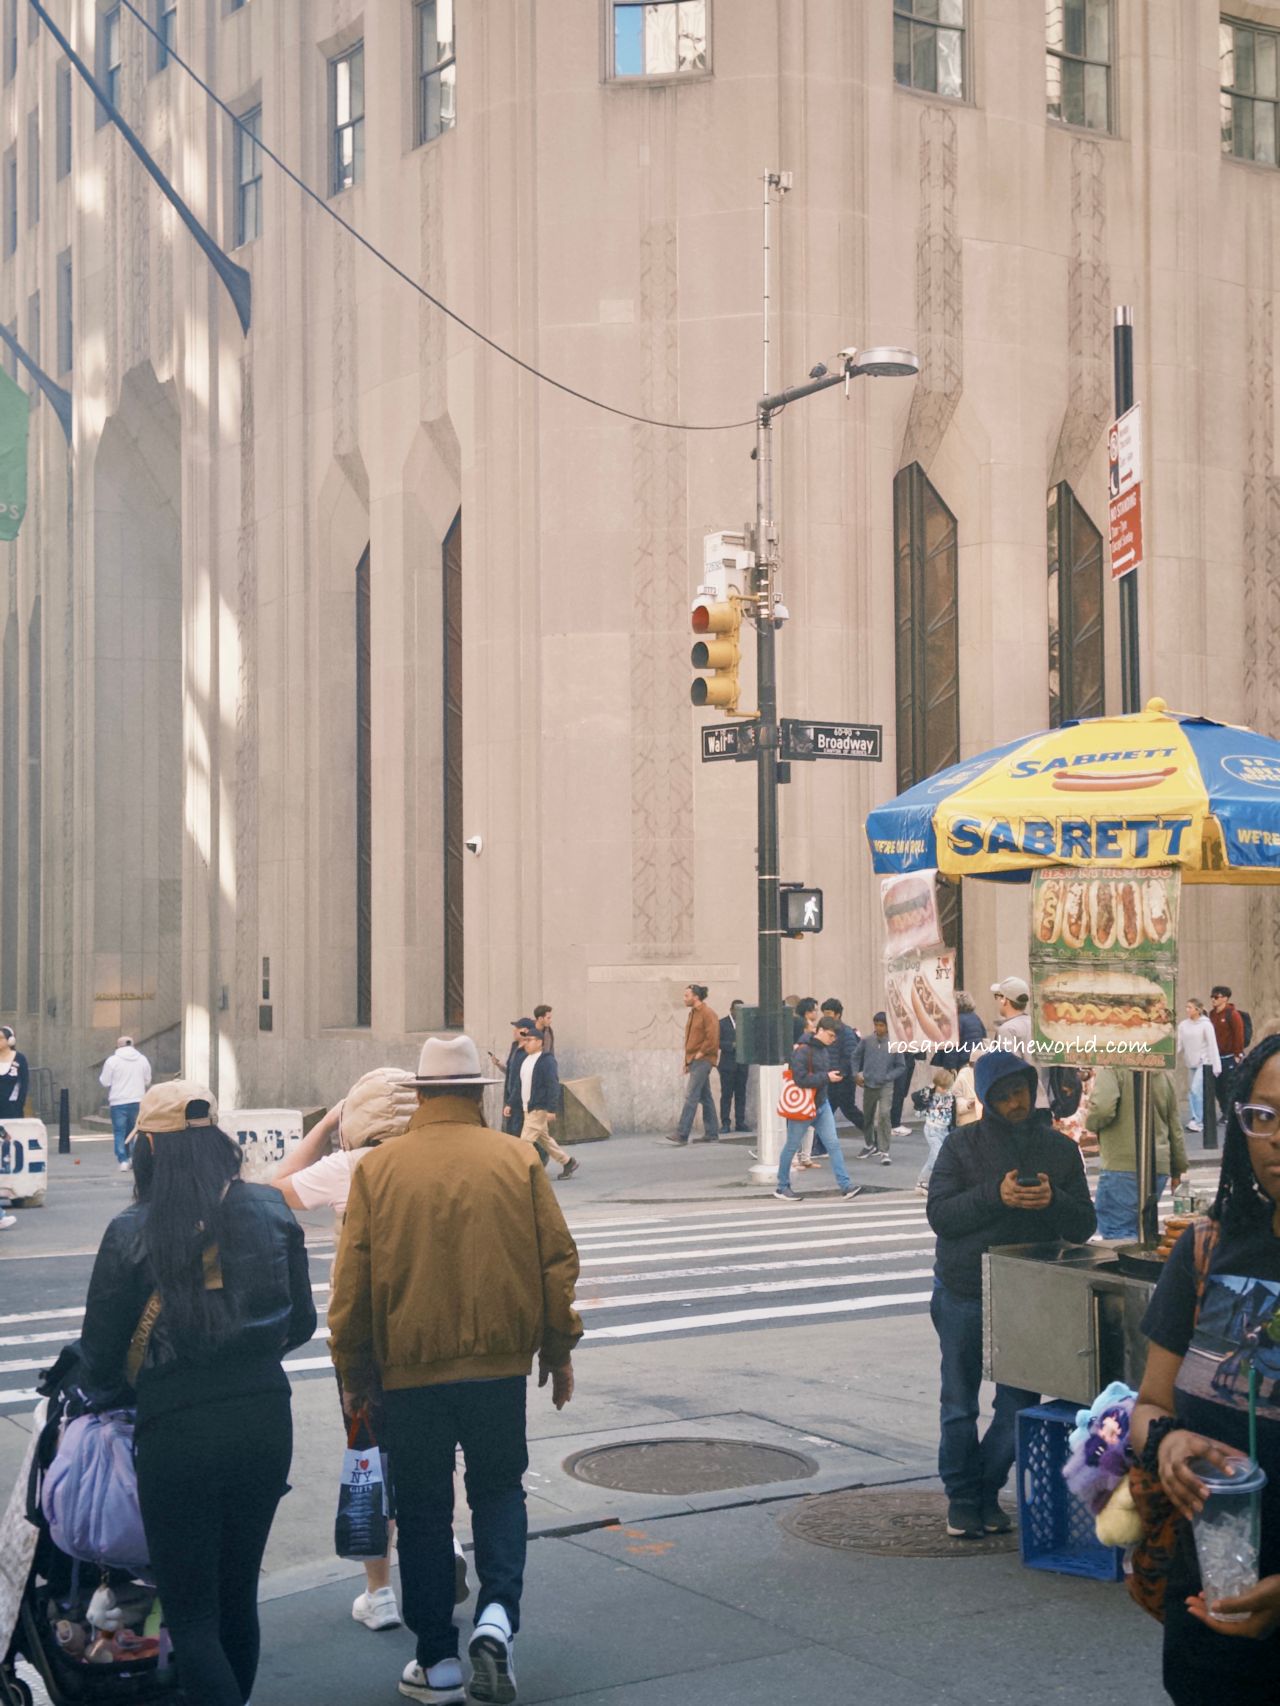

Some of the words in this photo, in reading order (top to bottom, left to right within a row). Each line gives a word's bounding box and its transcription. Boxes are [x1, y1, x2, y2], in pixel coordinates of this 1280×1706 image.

[708, 733, 727, 753] Wall
[818, 734, 874, 754] Broadway
[1009, 748, 1178, 778] SABRETT
[948, 814, 1193, 858] SABRETT
[1137, 867, 1172, 878] DOG
[904, 960, 920, 972] Dog
[935, 967, 952, 980] NY
[350, 1471, 373, 1483] NY
